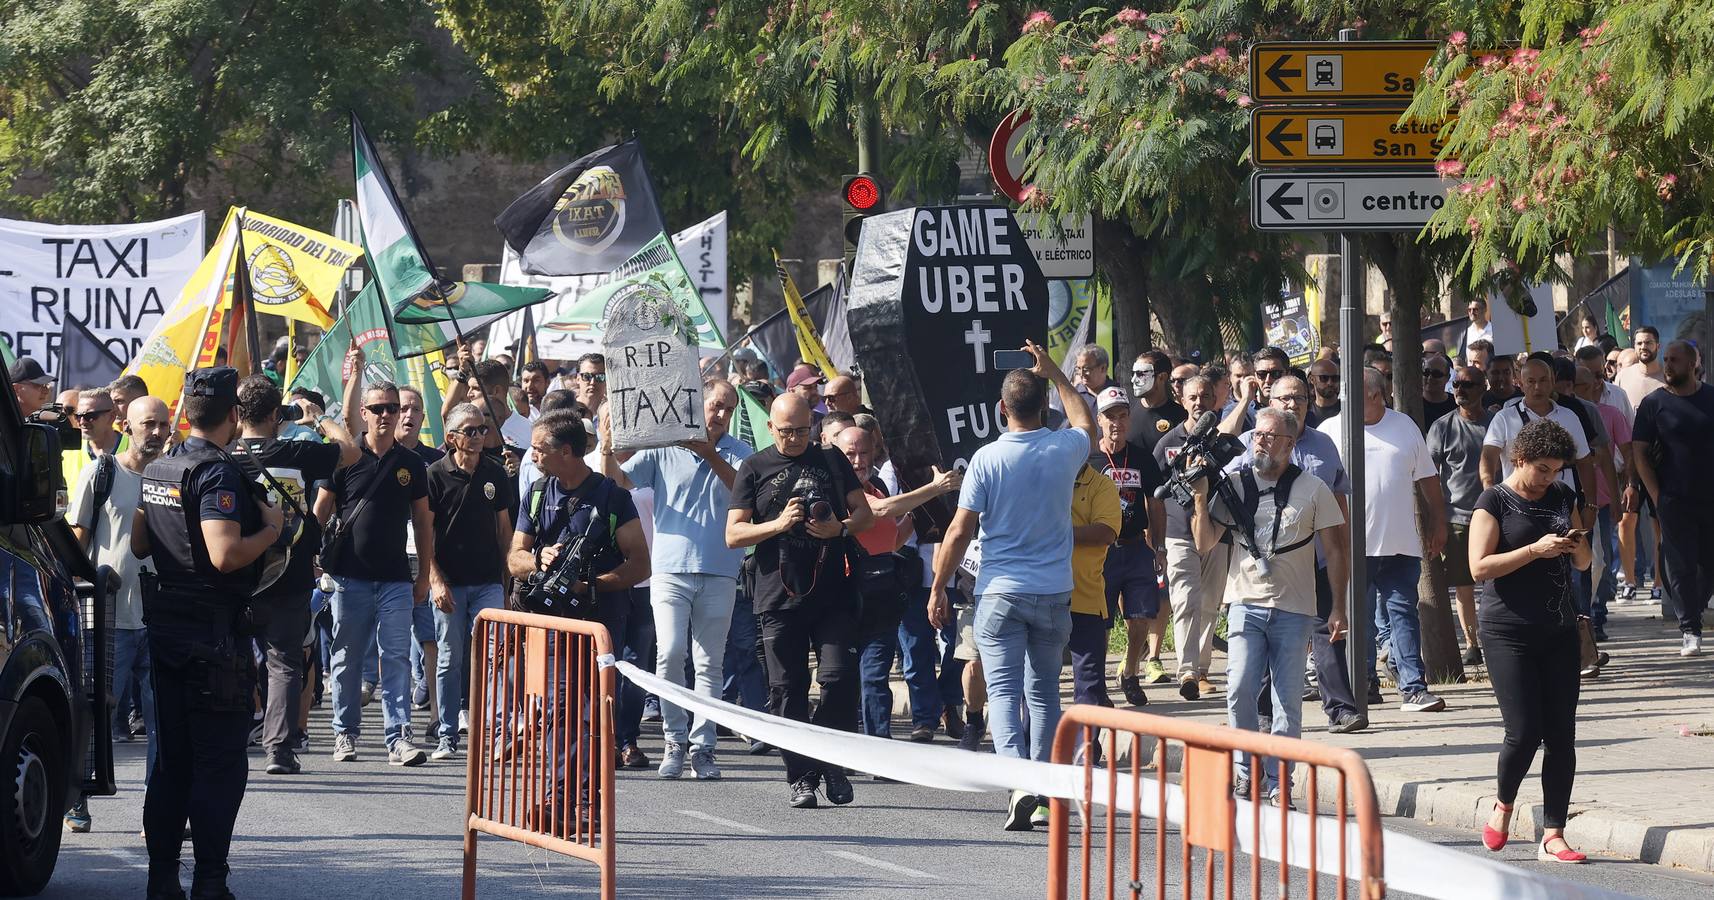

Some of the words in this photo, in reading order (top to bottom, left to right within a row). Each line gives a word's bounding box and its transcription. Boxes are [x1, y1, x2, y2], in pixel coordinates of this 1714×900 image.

[1373, 138, 1416, 157] San
[1362, 190, 1445, 211] centro
[914, 208, 1012, 257] GAME
[42, 238, 149, 278] TAXI
[302, 239, 327, 259] DEL
[1045, 248, 1092, 261] ELÉCTRICO
[919, 264, 1028, 313] UBER
[1664, 289, 1697, 298] ADESLAS
[31, 286, 166, 330] RUINA
[612, 385, 700, 430] TAXI
[947, 401, 1009, 443] FUC
[143, 493, 182, 508] NACIONAL
